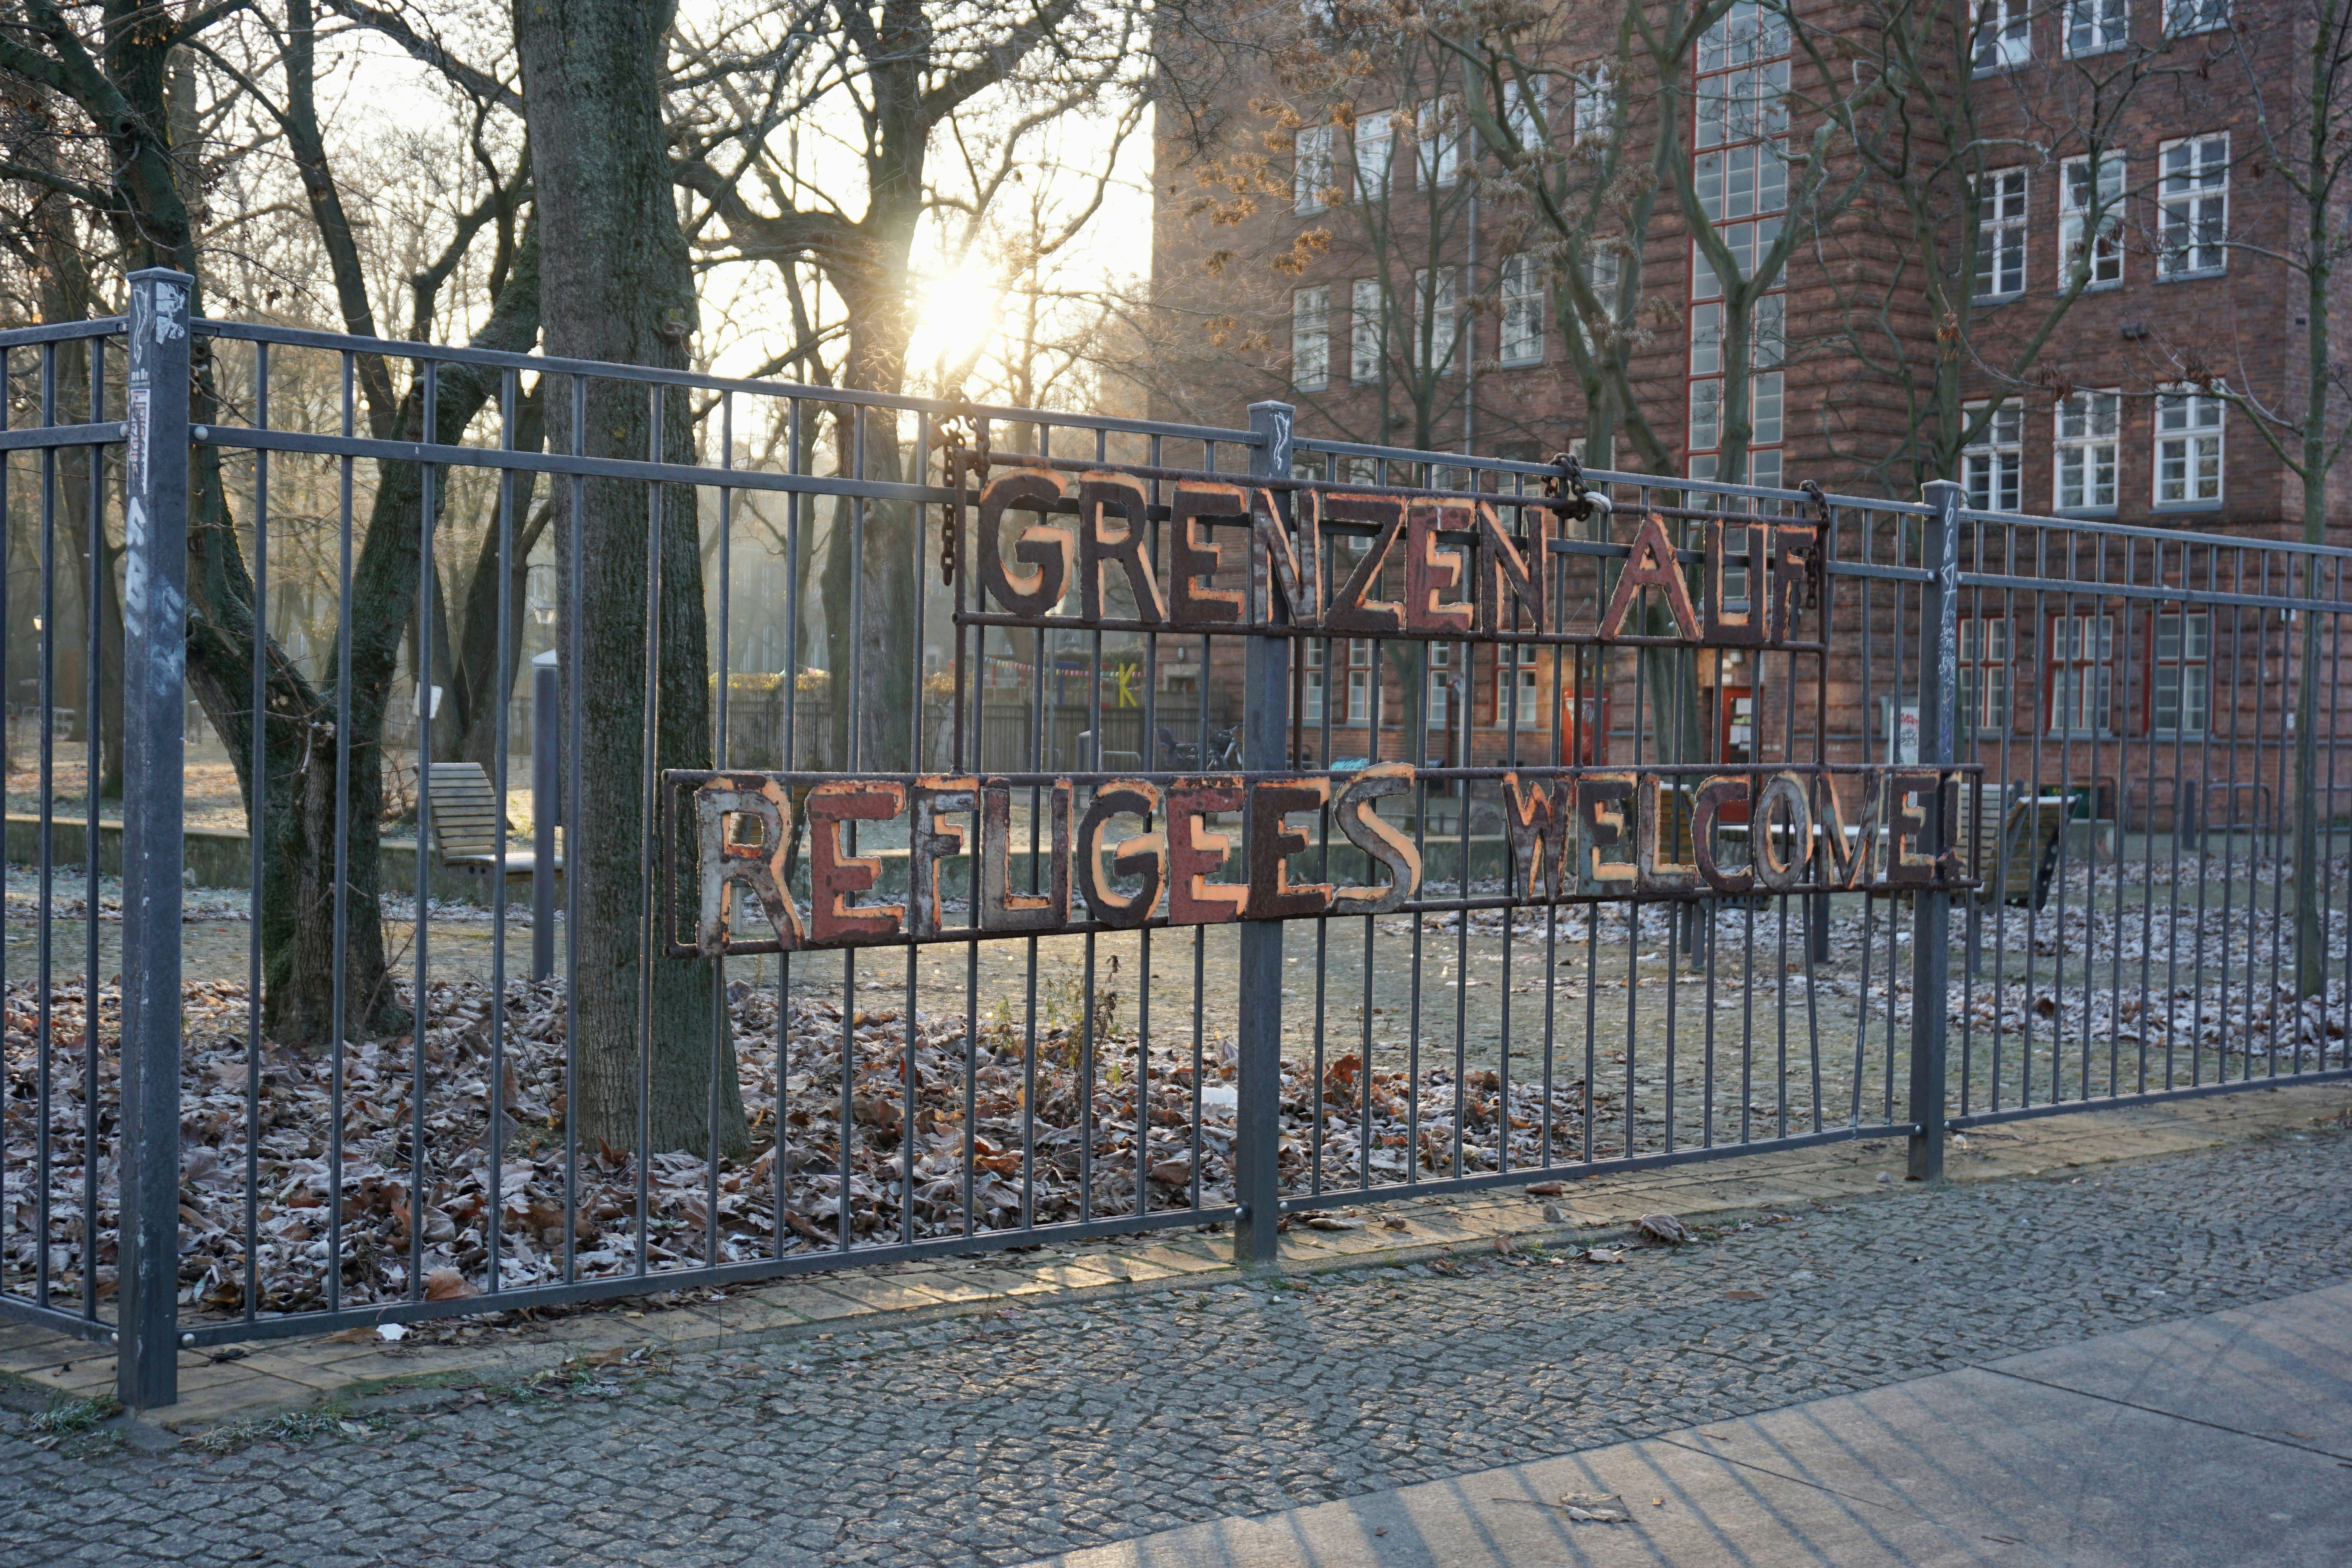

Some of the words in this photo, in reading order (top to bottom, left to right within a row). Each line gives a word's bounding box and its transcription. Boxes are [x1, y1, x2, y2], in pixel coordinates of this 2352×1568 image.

[977, 466, 1548, 638] GRENZEN
[1596, 512, 1818, 645] AUF
[694, 761, 1422, 955] REFUGEES
[1501, 769, 1968, 905] WELCOME!
